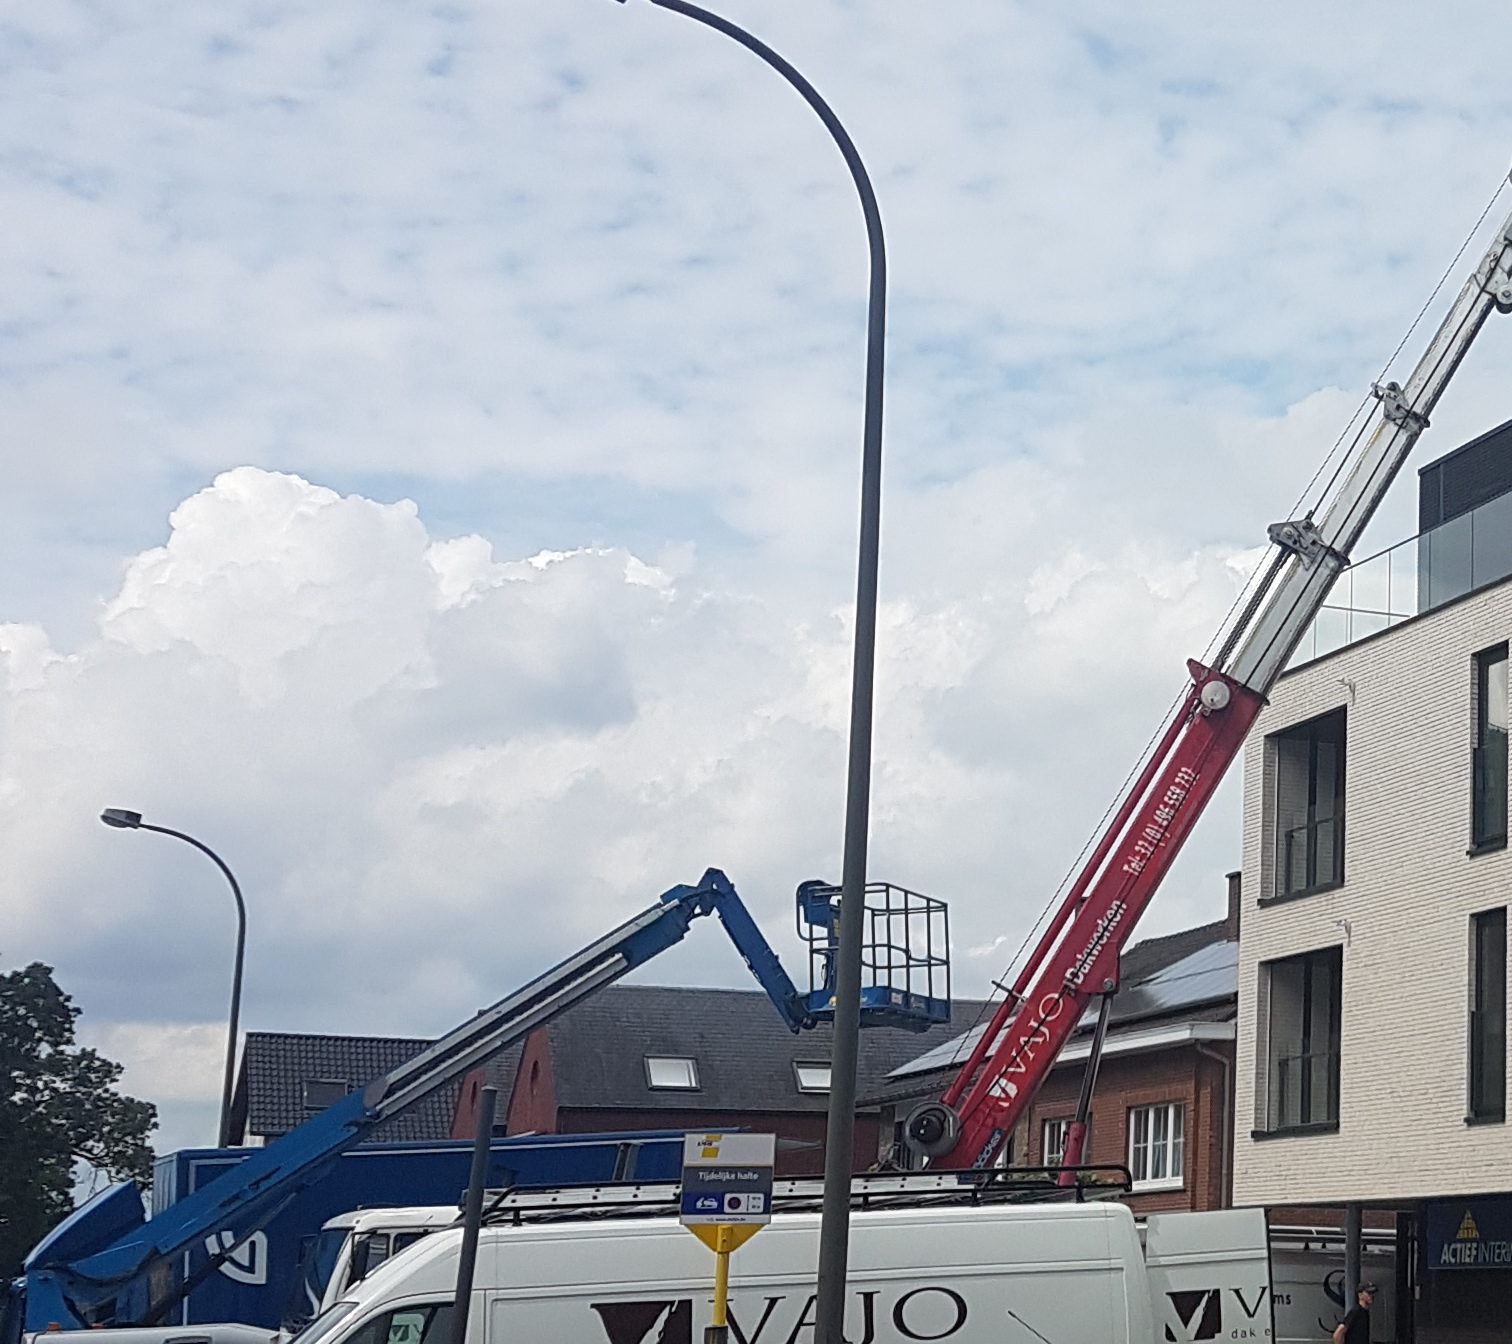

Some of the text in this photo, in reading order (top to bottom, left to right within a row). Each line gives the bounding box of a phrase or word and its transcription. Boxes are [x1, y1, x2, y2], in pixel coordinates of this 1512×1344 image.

[1003, 992, 1064, 1074] VAJO
[1440, 1242, 1477, 1264] ACTIEF
[1231, 1328, 1256, 1339] dak
